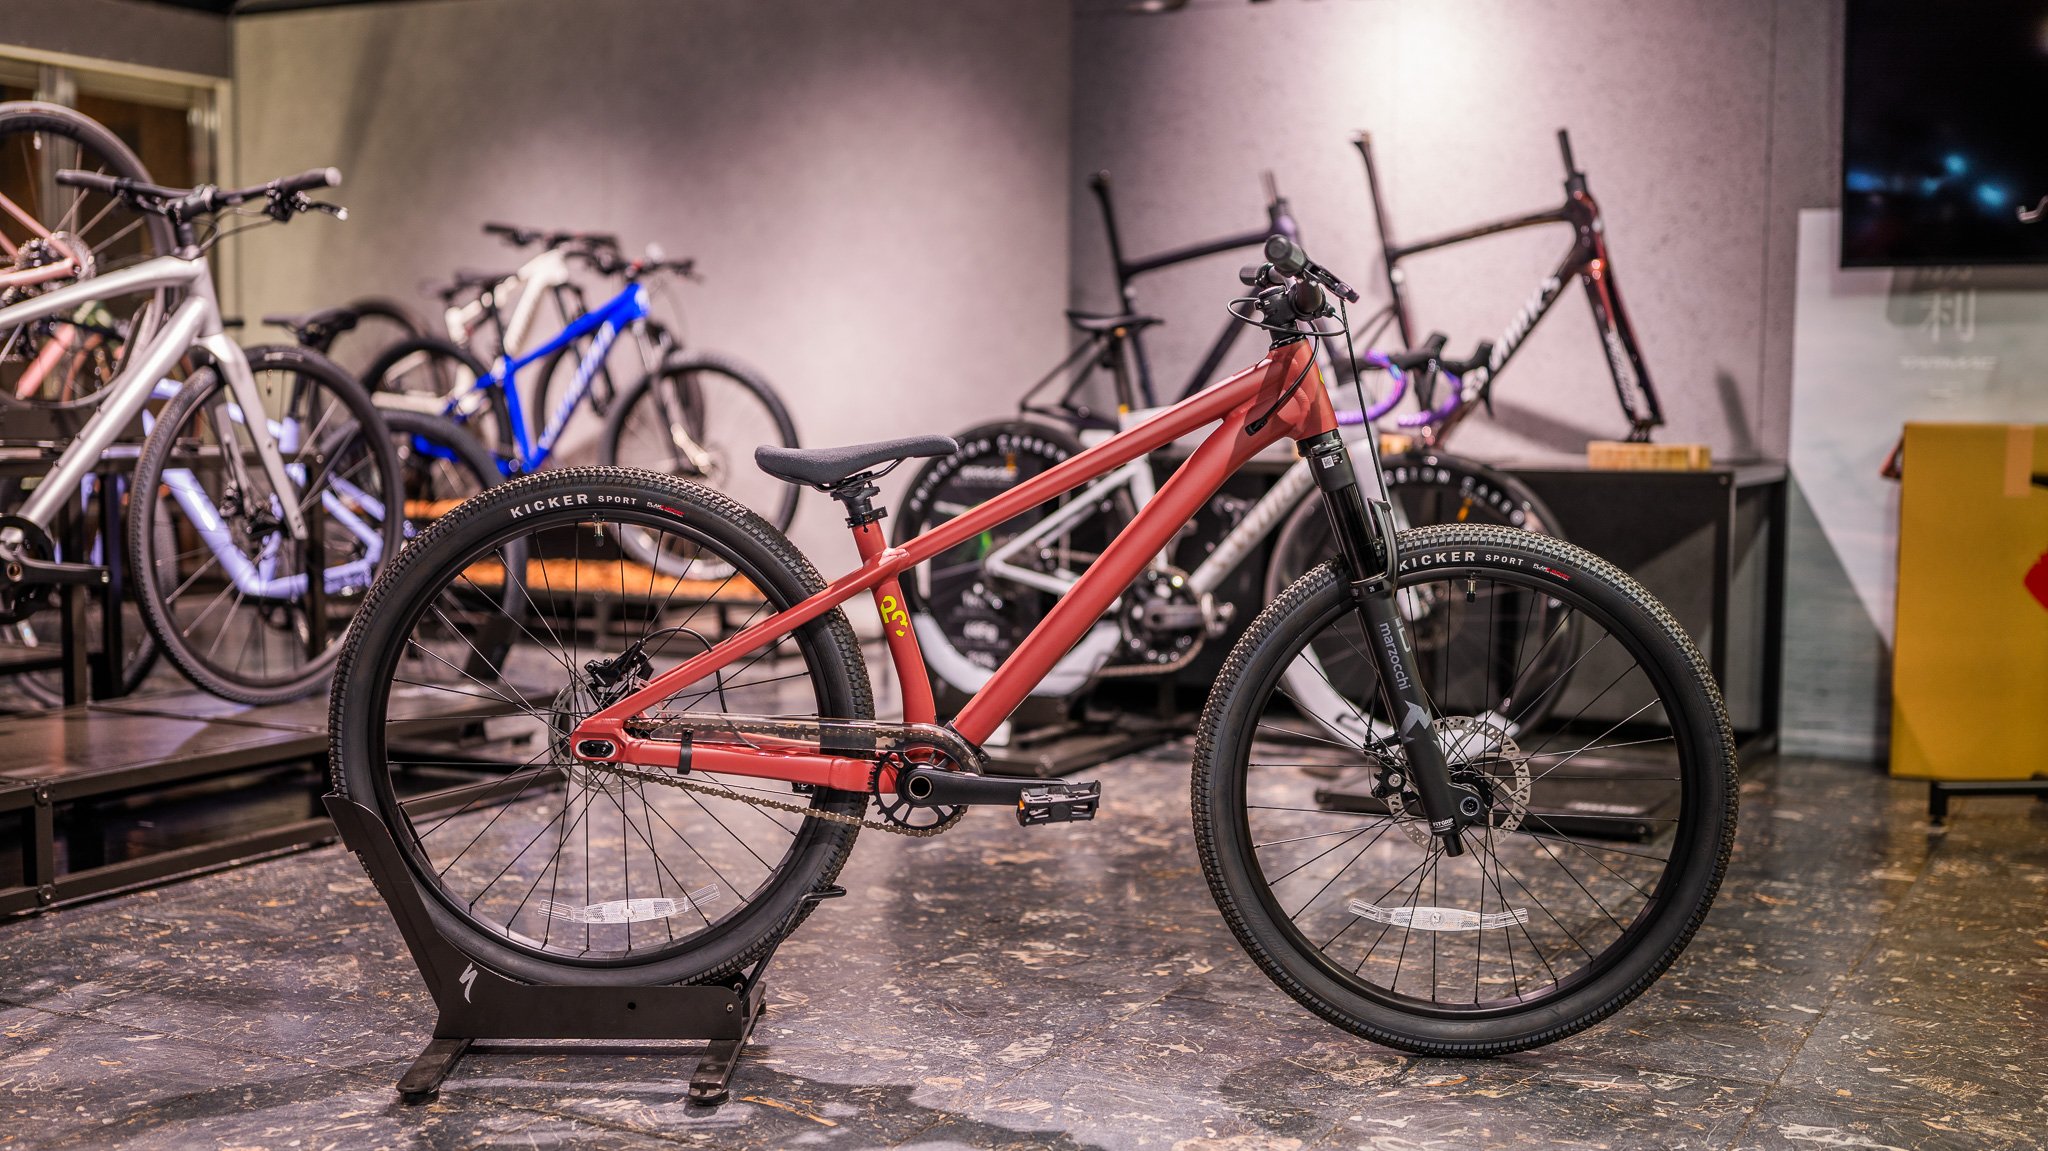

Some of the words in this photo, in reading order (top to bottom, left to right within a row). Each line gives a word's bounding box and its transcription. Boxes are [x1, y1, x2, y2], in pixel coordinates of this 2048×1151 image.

[510, 493, 589, 519] KICKER
[598, 494, 637, 505] SPORT
[1400, 551, 1476, 572] KICKER
[1485, 553, 1524, 566] SPORT
[1379, 622, 1411, 690] marzocchi
